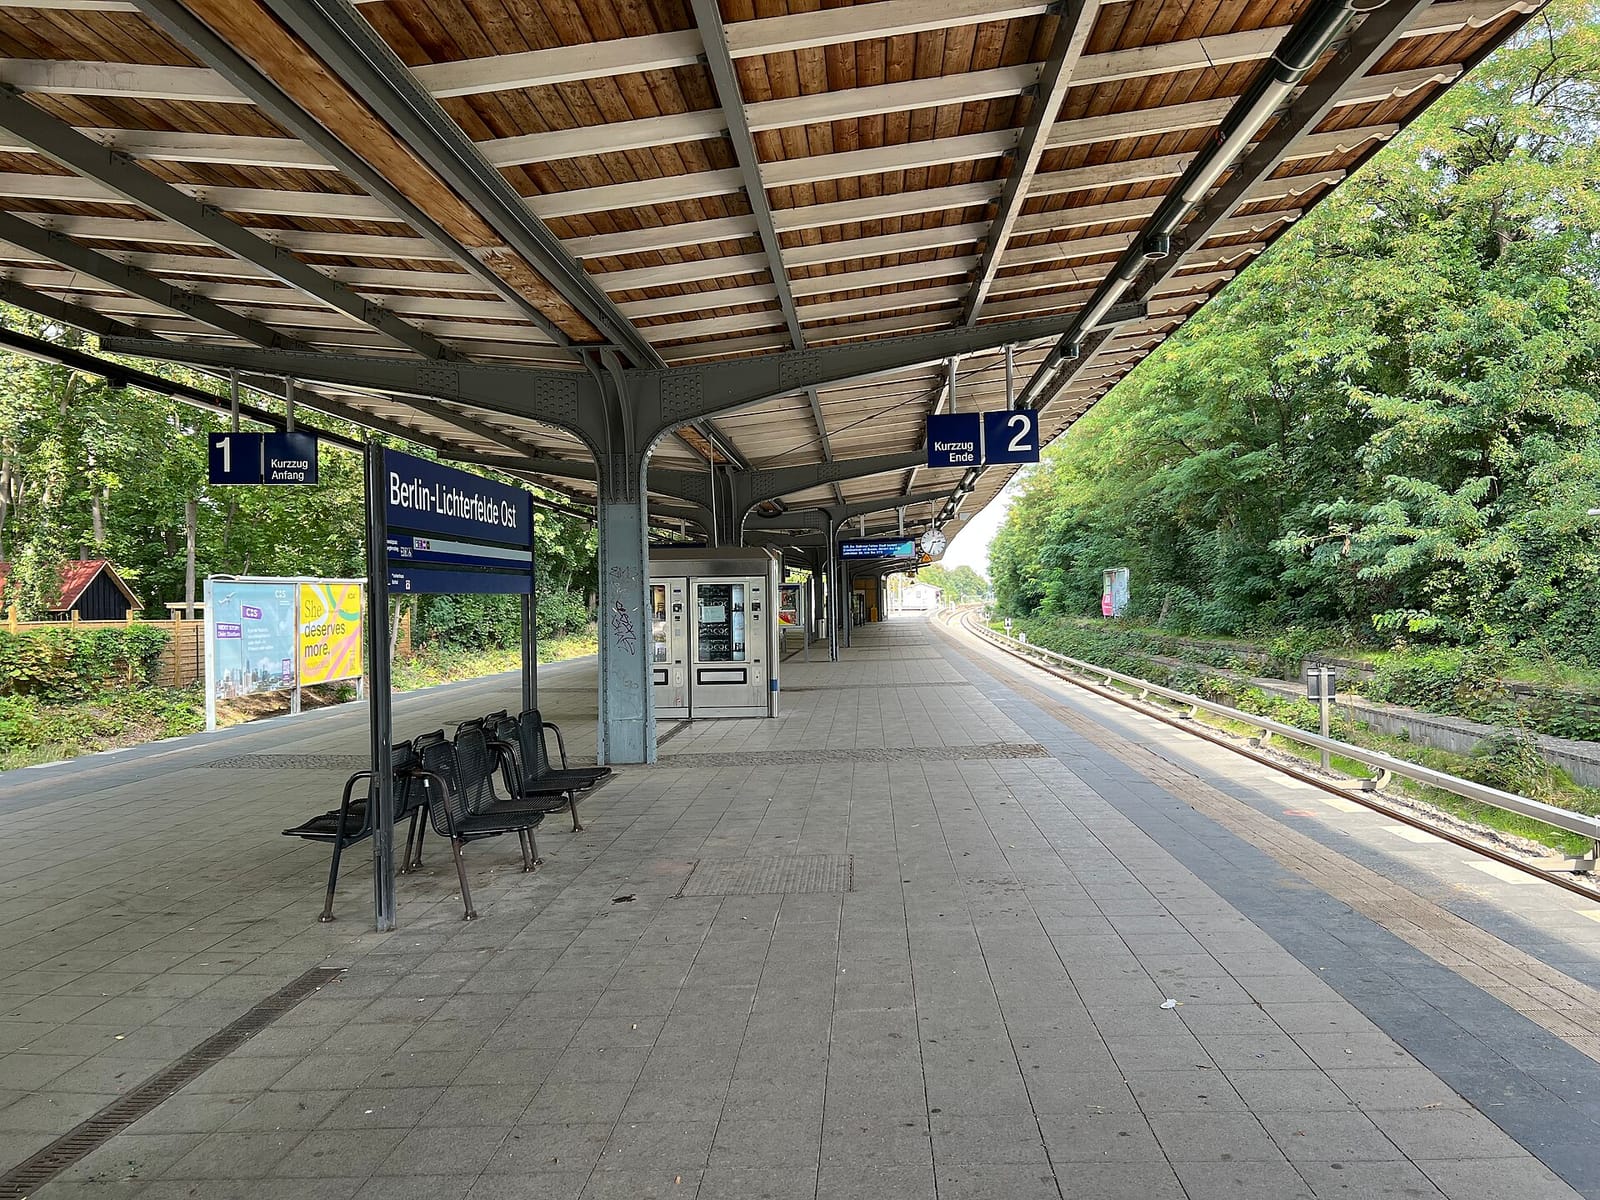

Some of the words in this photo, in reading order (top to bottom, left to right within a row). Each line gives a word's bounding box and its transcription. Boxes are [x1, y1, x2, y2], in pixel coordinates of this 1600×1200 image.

[1007, 414, 1032, 452] 2
[215, 436, 231, 473] 1
[934, 441, 974, 452] Kurzzug
[271, 458, 309, 470] Kurzzug
[949, 452, 974, 463] Ende
[271, 470, 305, 482] Anfang
[389, 471, 499, 525] Berlin-Lichterfelde
[500, 500, 517, 529] Ost
[304, 599, 322, 618] She
[304, 621, 346, 638] deserves
[304, 642, 331, 658] more.
